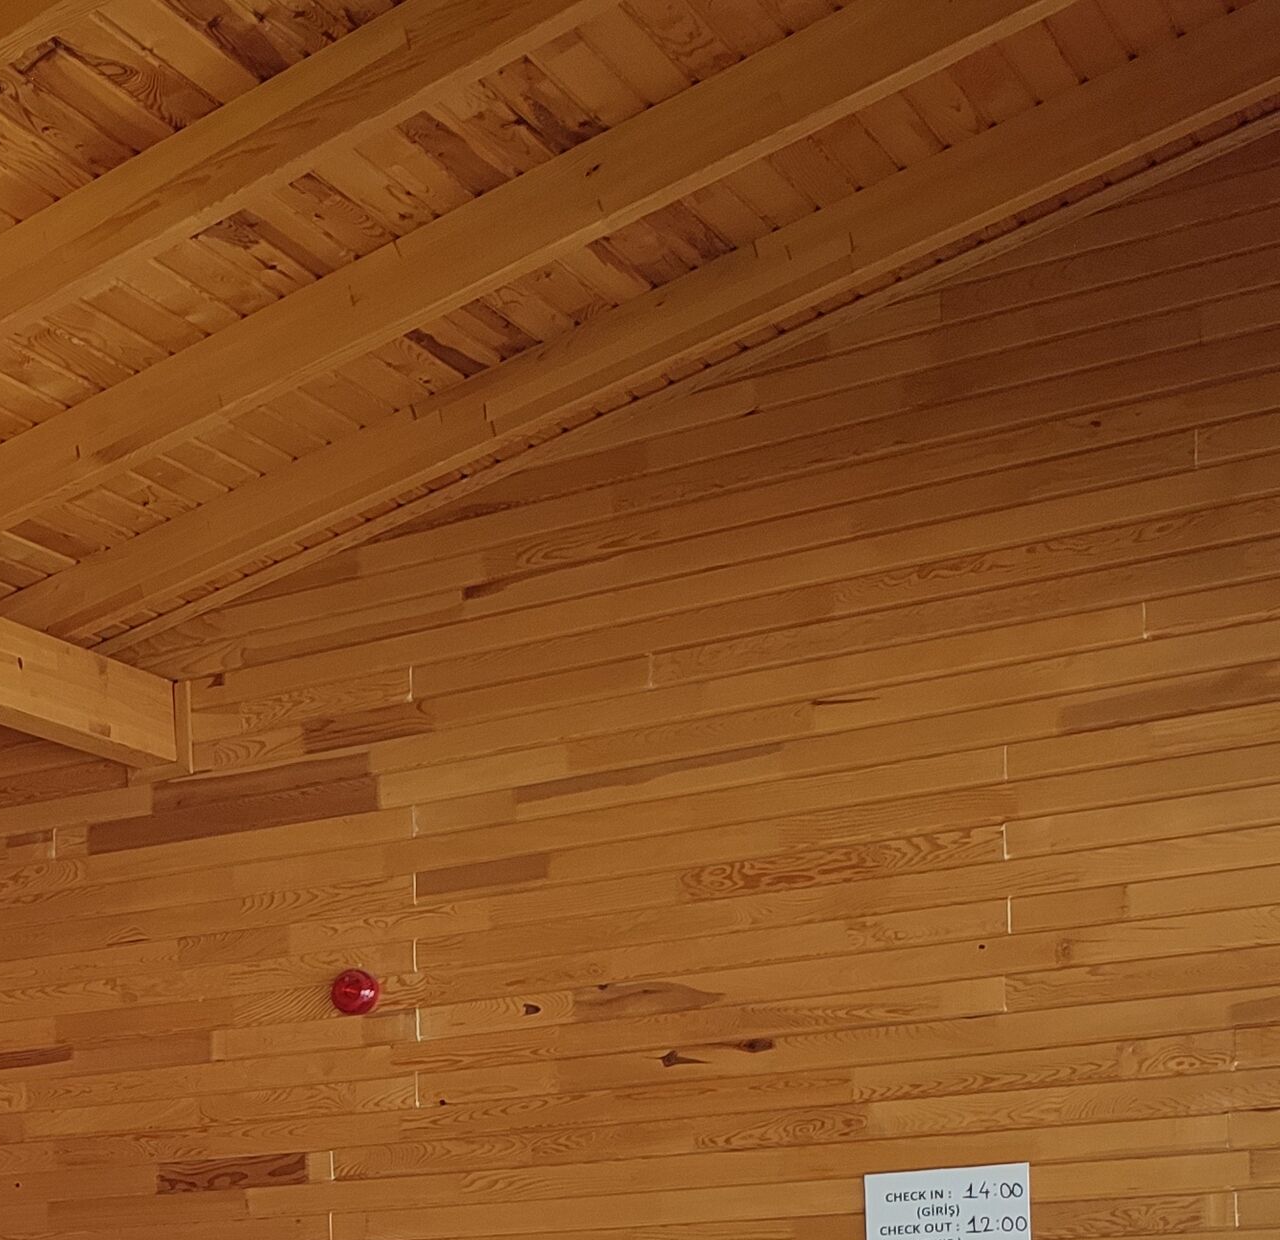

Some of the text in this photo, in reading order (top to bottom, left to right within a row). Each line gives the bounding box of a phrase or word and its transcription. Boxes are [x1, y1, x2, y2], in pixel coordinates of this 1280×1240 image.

[885, 1190, 926, 1203] CHECK
[930, 1189, 944, 1199] IN
[962, 1181, 1024, 1199] 14:00
[917, 1203, 960, 1219] (GİRİŞ)
[880, 1225, 921, 1236] CHECK
[924, 1222, 952, 1233] OUT
[966, 1215, 1028, 1233] 12:00
